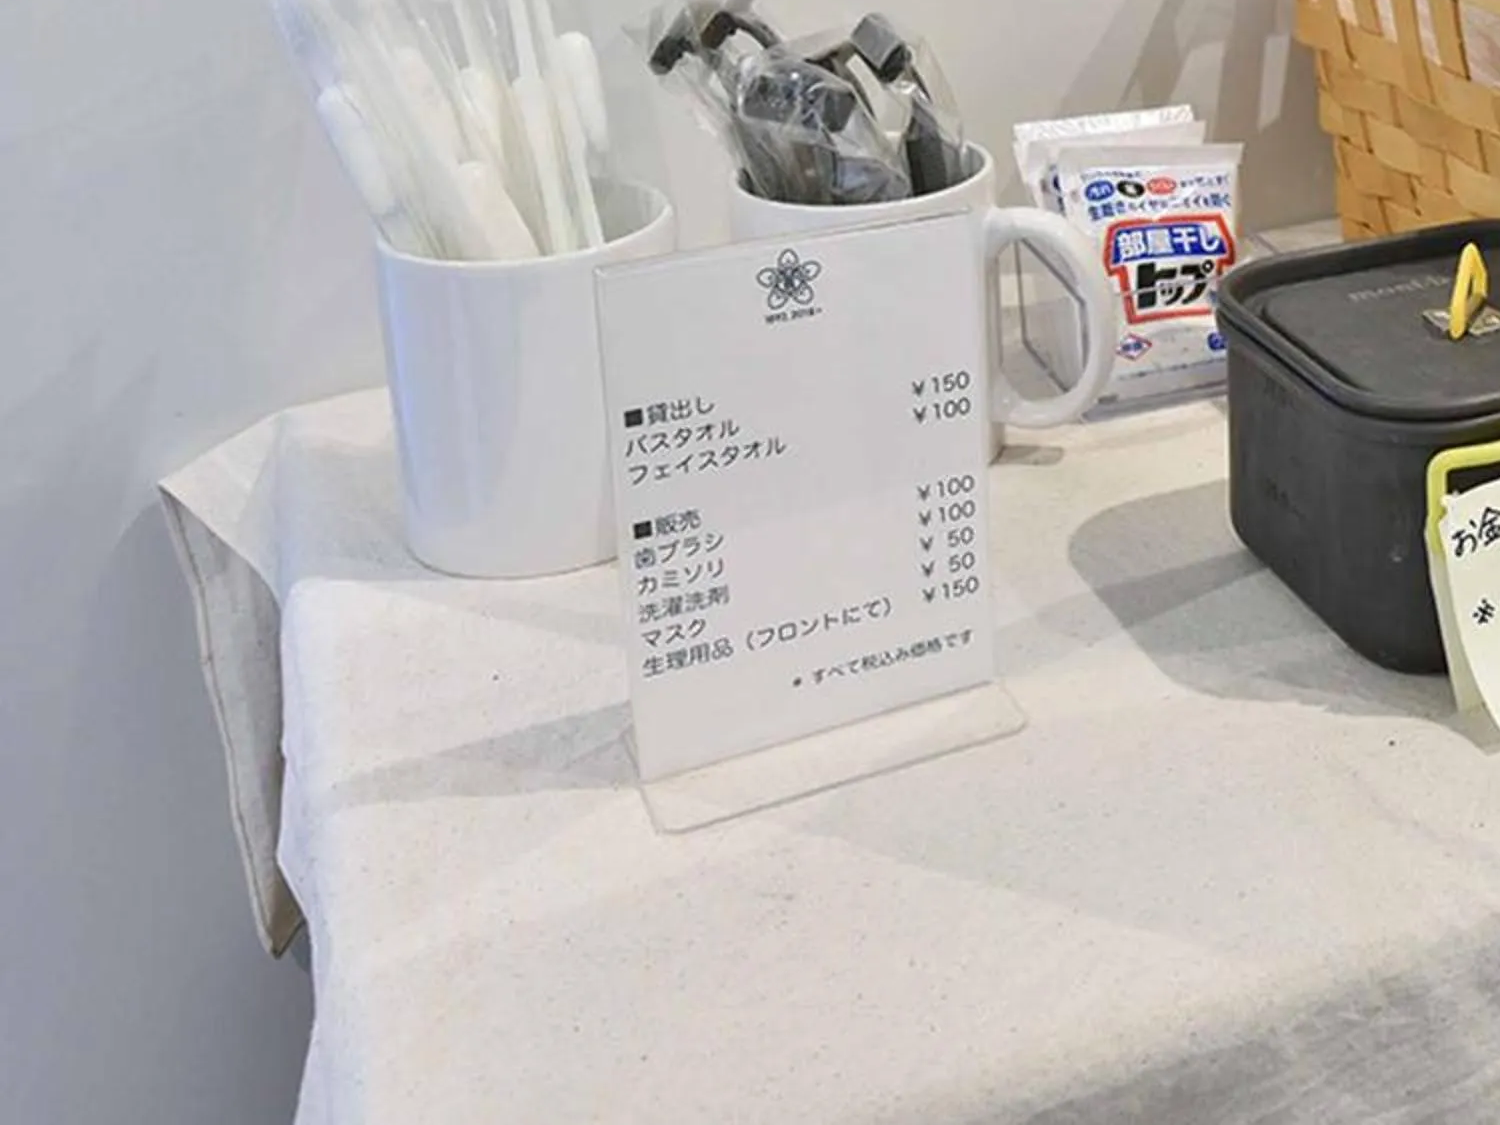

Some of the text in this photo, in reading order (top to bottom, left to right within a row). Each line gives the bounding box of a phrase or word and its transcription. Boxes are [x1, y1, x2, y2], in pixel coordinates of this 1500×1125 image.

[1117, 226, 1221, 262] 部屋干し
[1136, 259, 1215, 309] トップ
[625, 370, 970, 457] バスタオル ¥150
[647, 396, 714, 425] 貸出し
[628, 396, 971, 485] フェイスタオル ¥100
[634, 475, 975, 569] 歯ブラシ ¥100
[655, 509, 702, 536] 販売
[637, 499, 976, 595] カミソリ ¥100
[639, 584, 730, 623] 洗濯洗剤
[922, 575, 979, 603] ¥150
[641, 618, 706, 647] マスク
